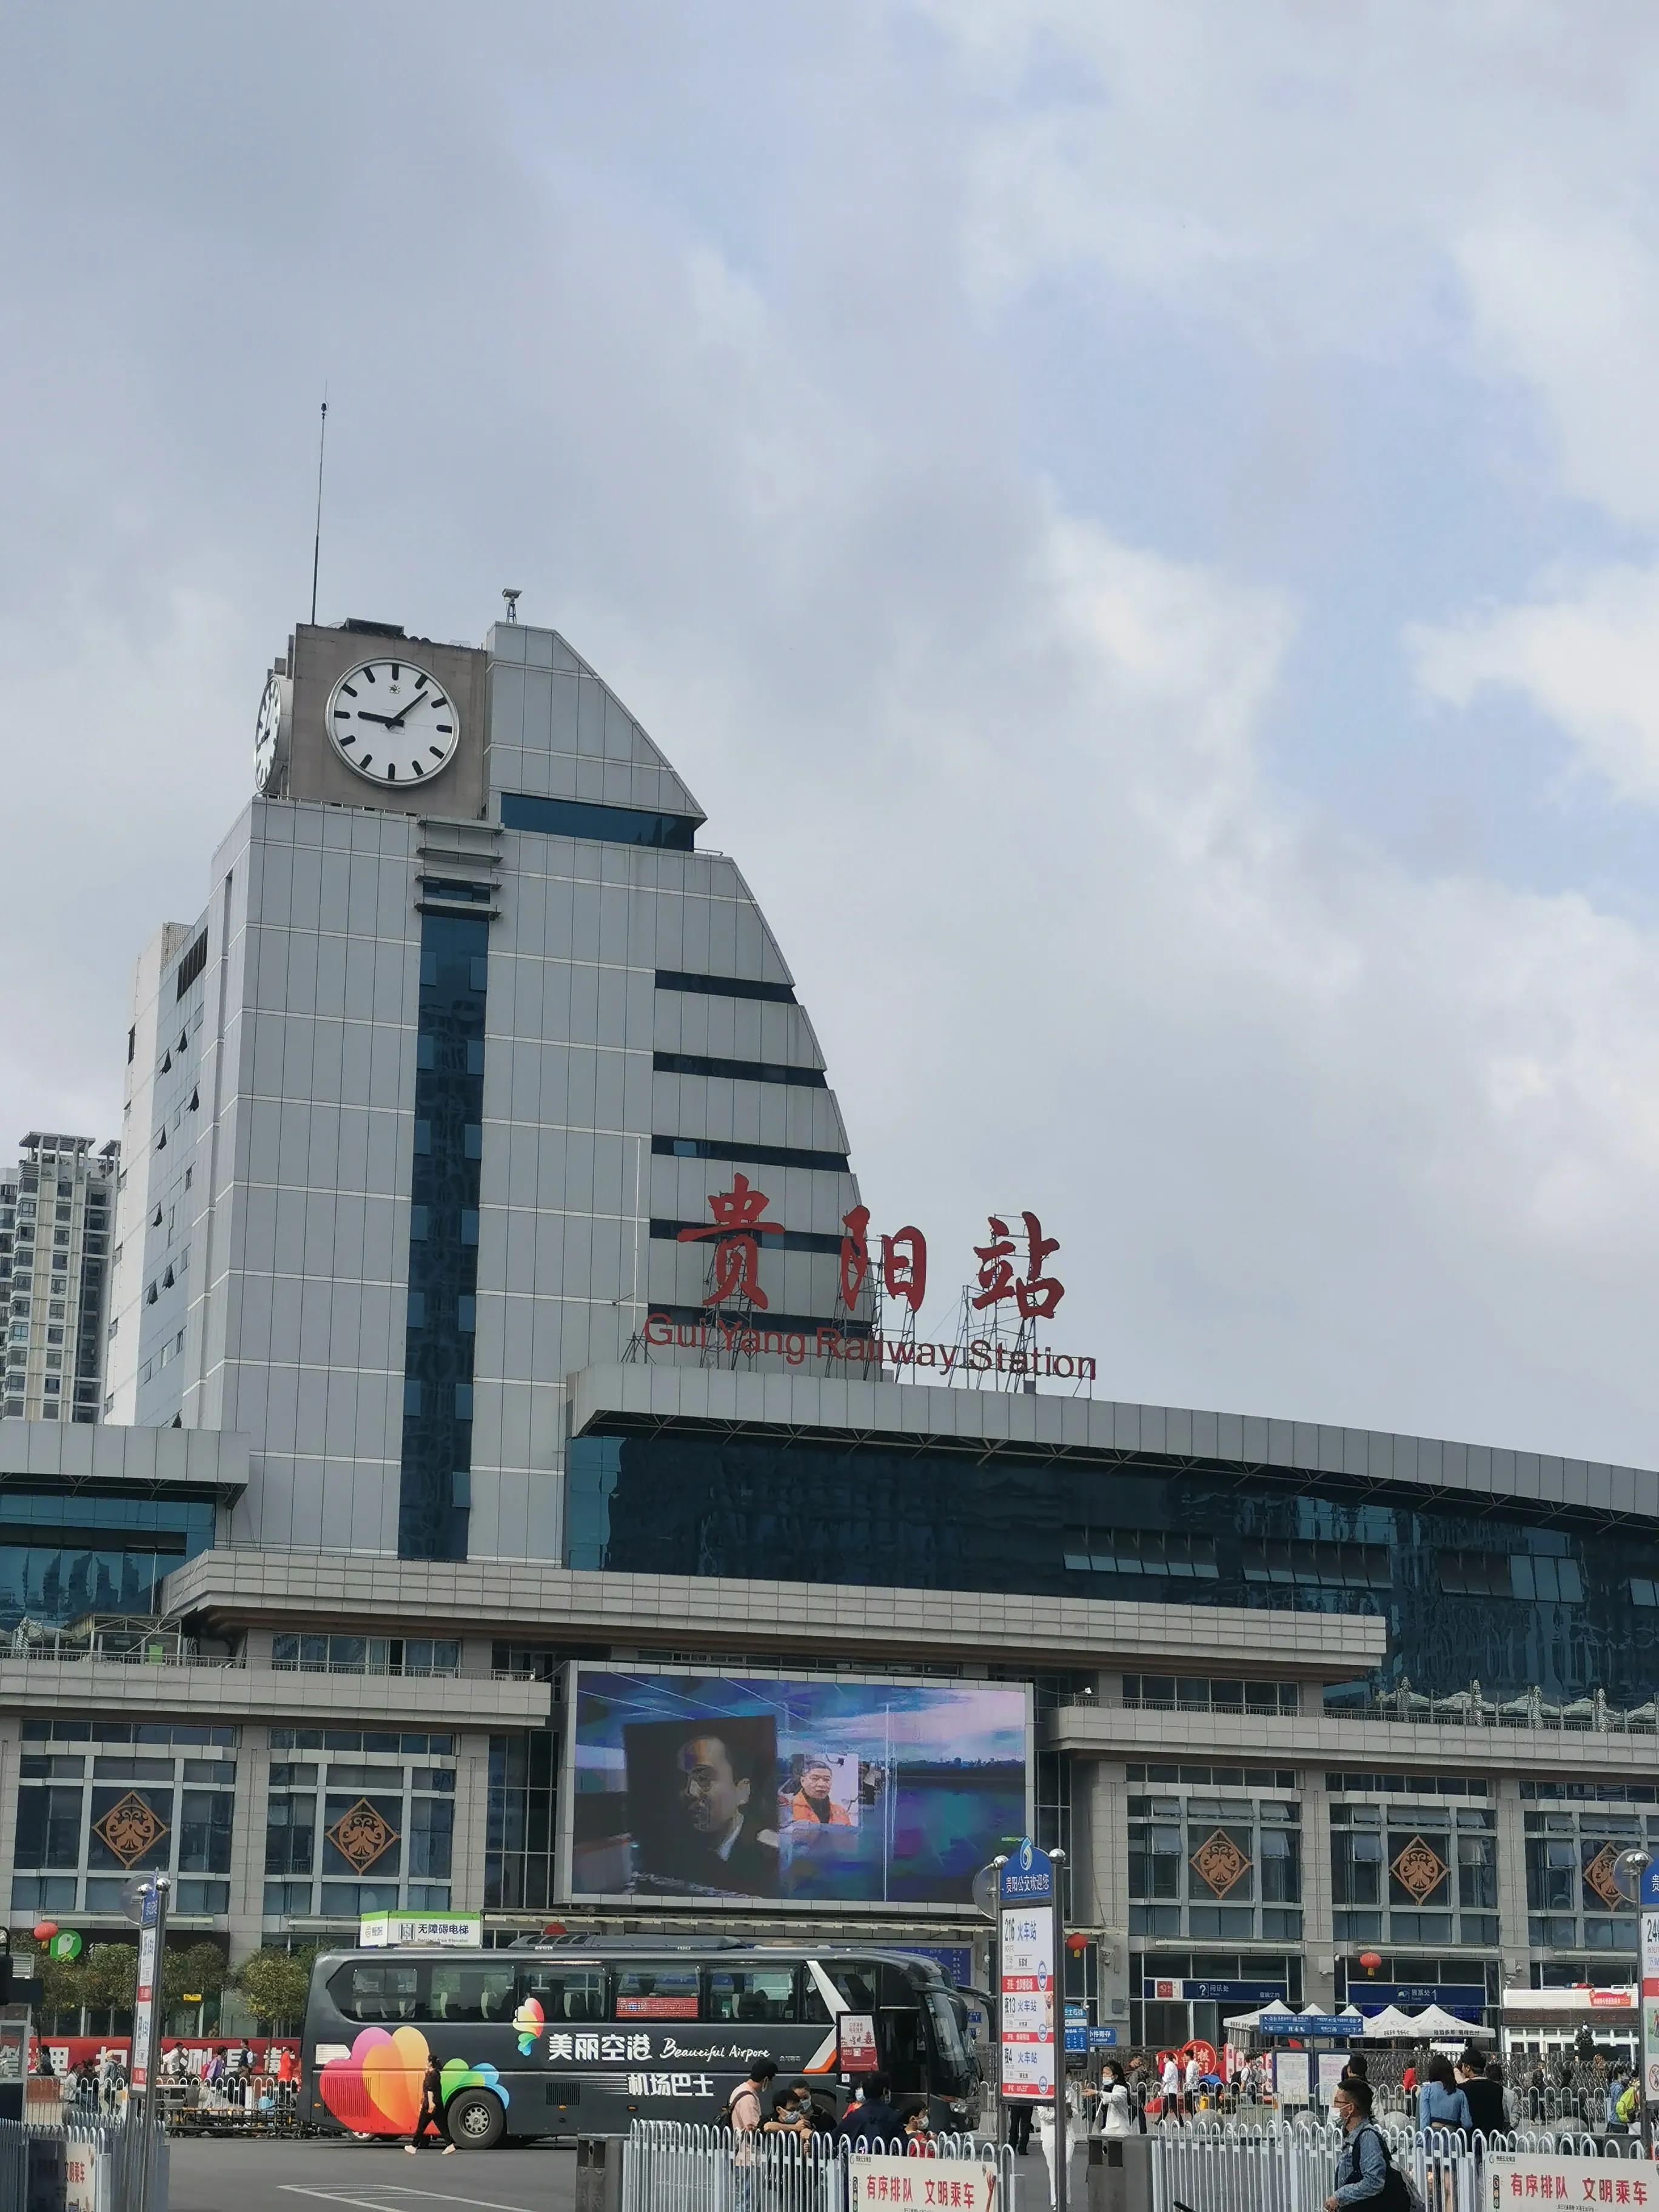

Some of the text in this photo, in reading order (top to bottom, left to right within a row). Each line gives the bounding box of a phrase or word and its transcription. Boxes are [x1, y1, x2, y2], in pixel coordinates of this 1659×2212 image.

[677, 1172, 1065, 1319] 贵阳站
[644, 1313, 1096, 1380] Gui Yang Railway Station
[1005, 1873, 1050, 1893] 贵阳公交欢迎您
[418, 1923, 469, 1935] 无障碍电梯
[1005, 1917, 1037, 1941] 216 火车站
[1018, 2000, 1037, 2013] 火车站
[549, 2033, 652, 2062] 美丽空港
[659, 2037, 771, 2062] Beautiful Airport
[1018, 2051, 1037, 2063] 火车站
[628, 2073, 714, 2097] 机场巴士
[866, 2174, 975, 2209] 有序排队 文明乘车
[1510, 2173, 1648, 2206] 有序排队 文明乘车
